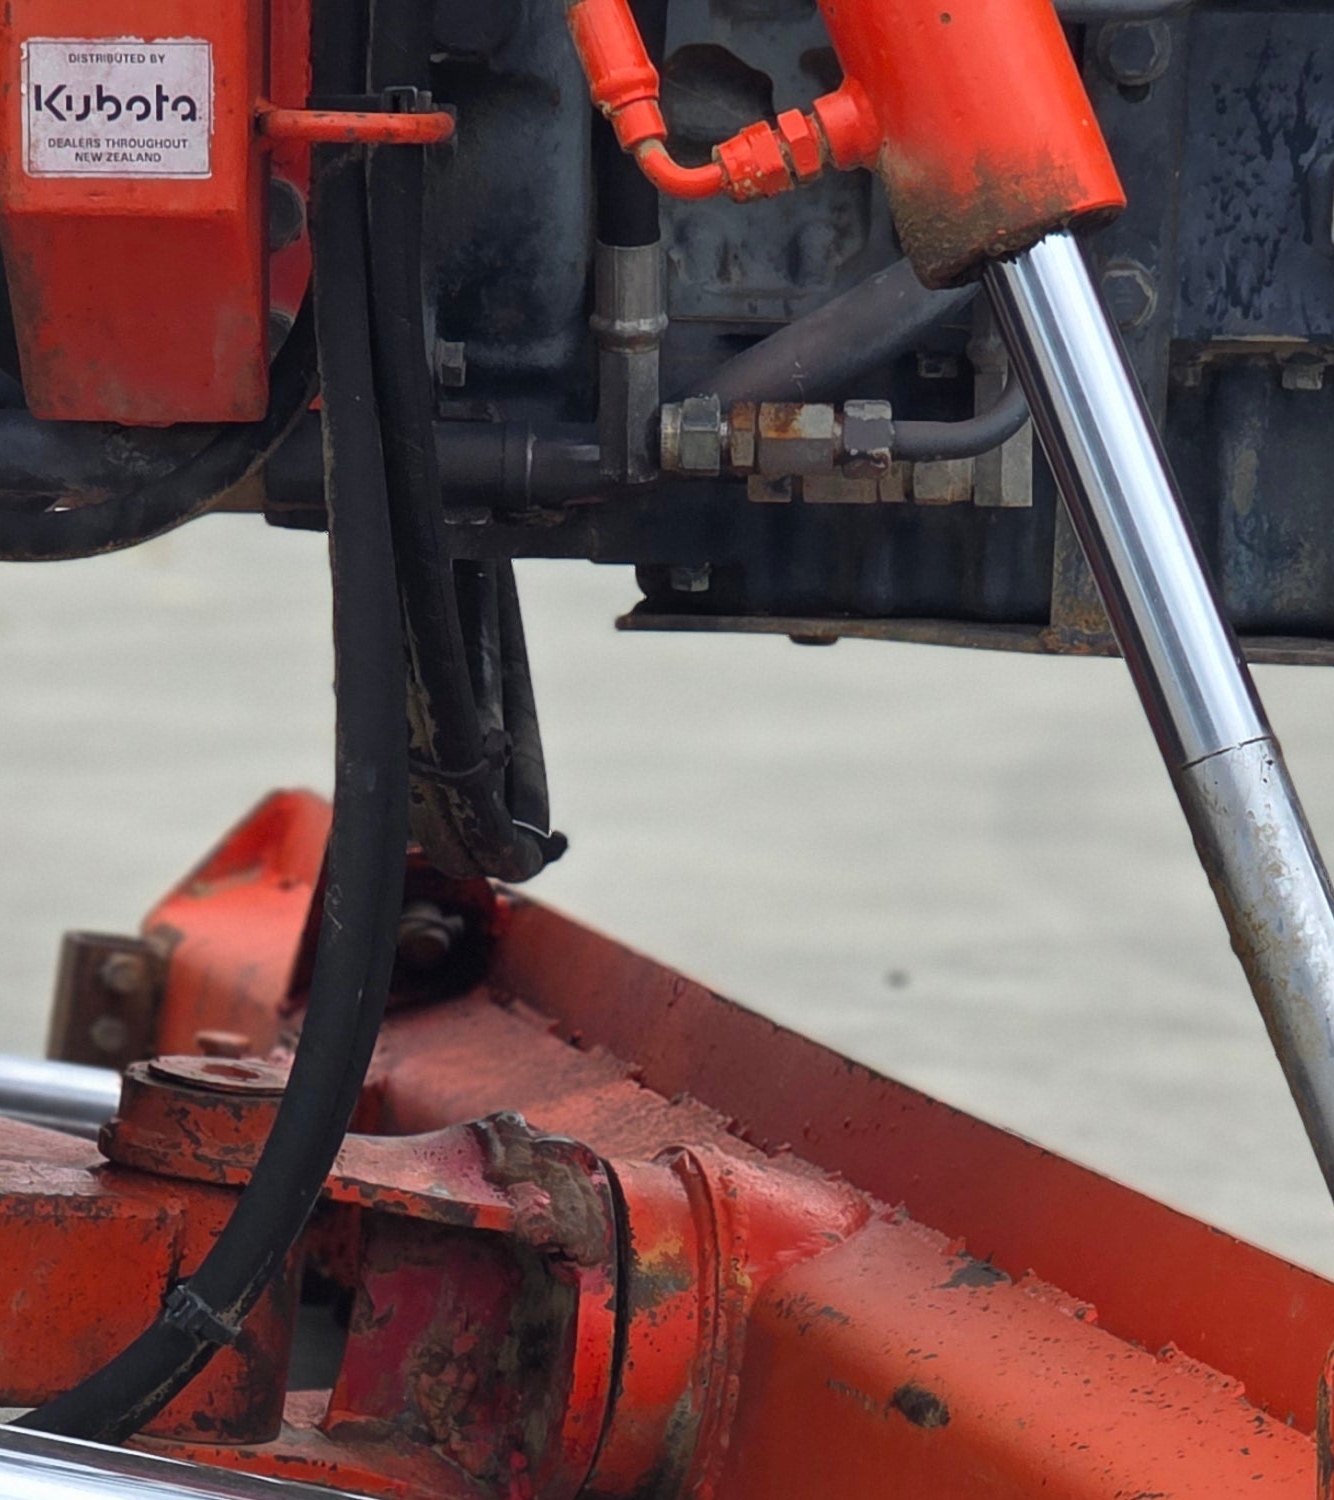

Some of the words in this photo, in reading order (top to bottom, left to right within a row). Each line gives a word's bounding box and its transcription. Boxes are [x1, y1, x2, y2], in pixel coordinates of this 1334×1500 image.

[68, 53, 146, 64] DISTRIBUTED
[150, 53, 166, 64] BY
[34, 84, 197, 121] Kubota
[47, 138, 101, 149] DEALERS
[105, 138, 188, 149] THROUGHOUT
[74, 152, 103, 162] NEW
[106, 152, 162, 162] ZEALAND
